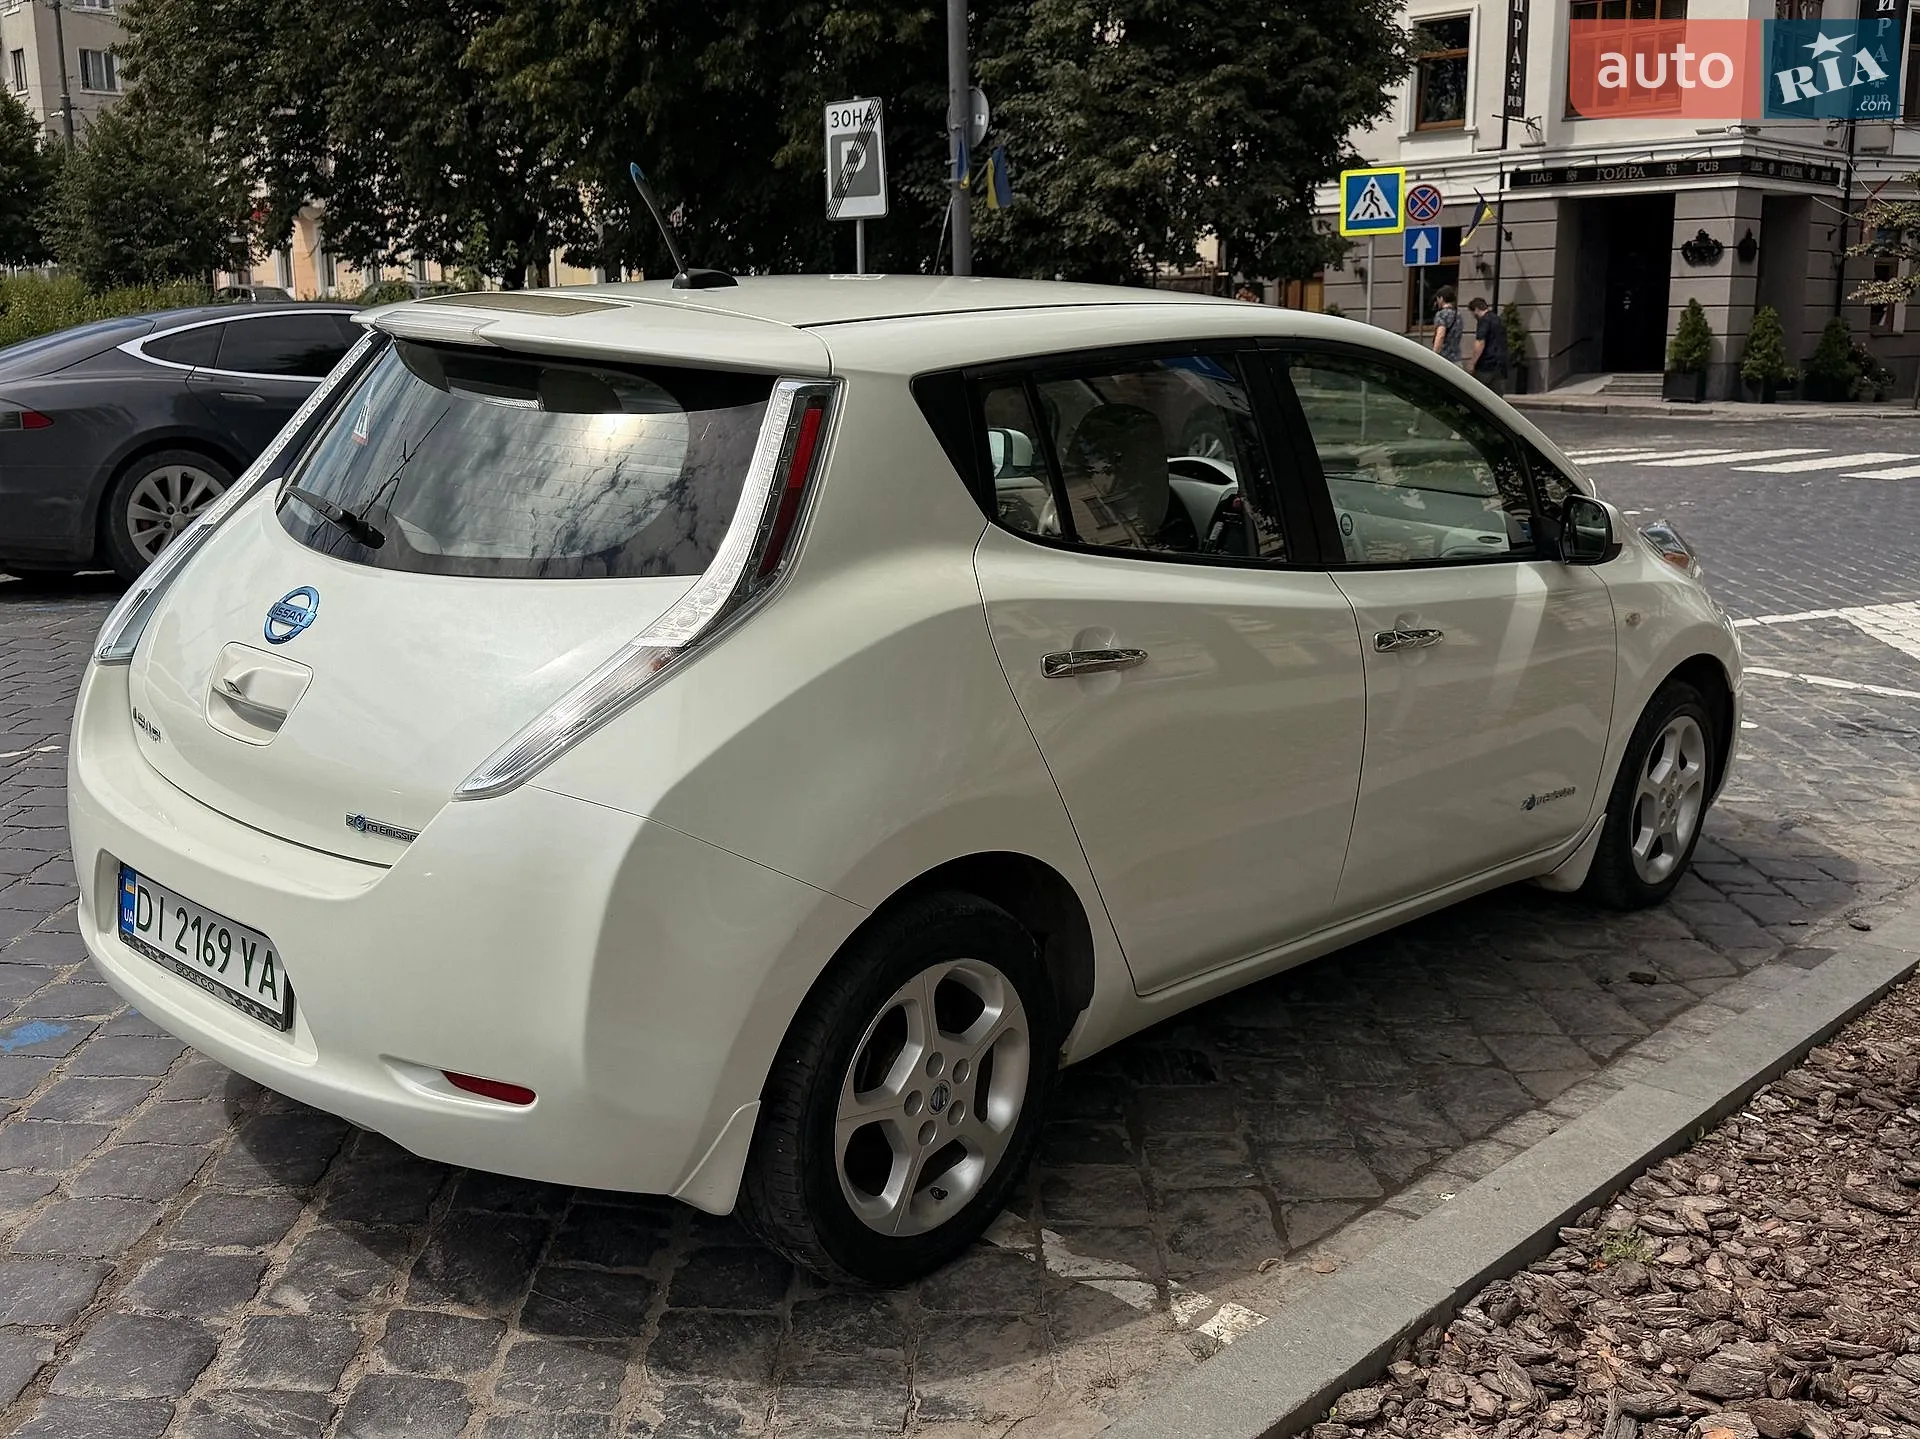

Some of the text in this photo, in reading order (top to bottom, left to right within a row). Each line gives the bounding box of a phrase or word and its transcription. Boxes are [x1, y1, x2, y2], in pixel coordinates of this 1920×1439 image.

[1530, 161, 1720, 183] ПАБ ГОЙРА PUB
[271, 604, 306, 622] NISSAN
[124, 907, 134, 925] UA
[136, 884, 278, 1001] DI 2169 YA
[175, 963, 215, 991] sparco
